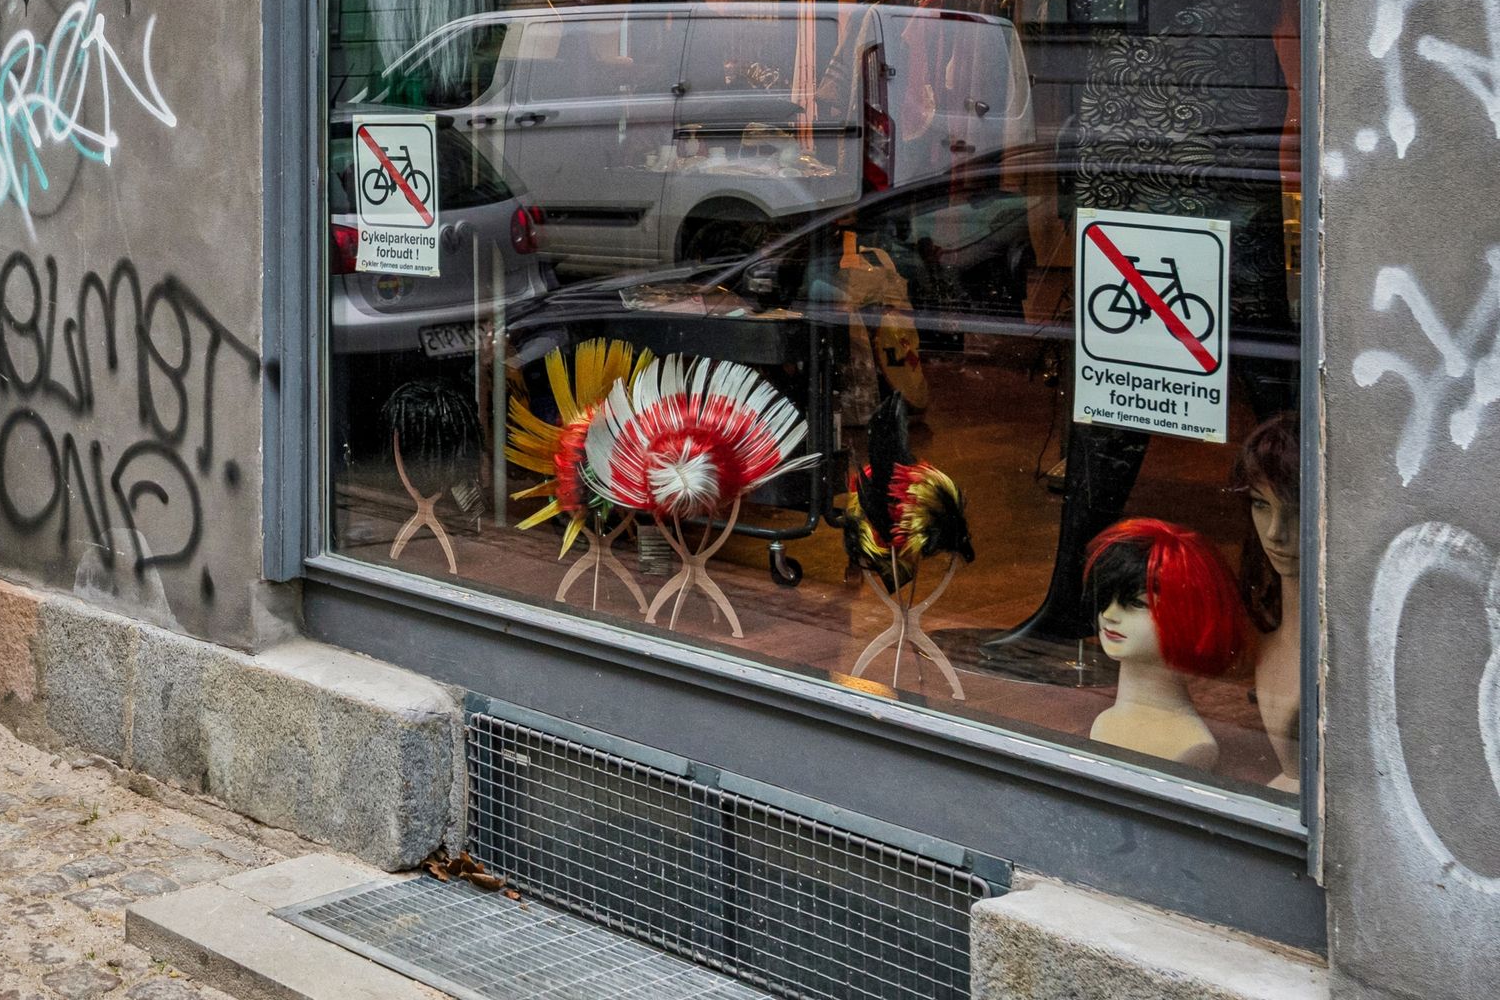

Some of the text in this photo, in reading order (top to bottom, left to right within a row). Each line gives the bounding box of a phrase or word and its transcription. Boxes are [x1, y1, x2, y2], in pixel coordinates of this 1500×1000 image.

[361, 231, 435, 249] Cykelparkering
[376, 246, 413, 259] forbudt
[380, 261, 398, 270] fjernes
[400, 262, 413, 270] uden
[1081, 365, 1220, 405] Cykelparkering
[1109, 390, 1177, 415] forbudt
[1083, 406, 1216, 434] Cykler fjernes uden ansvar
